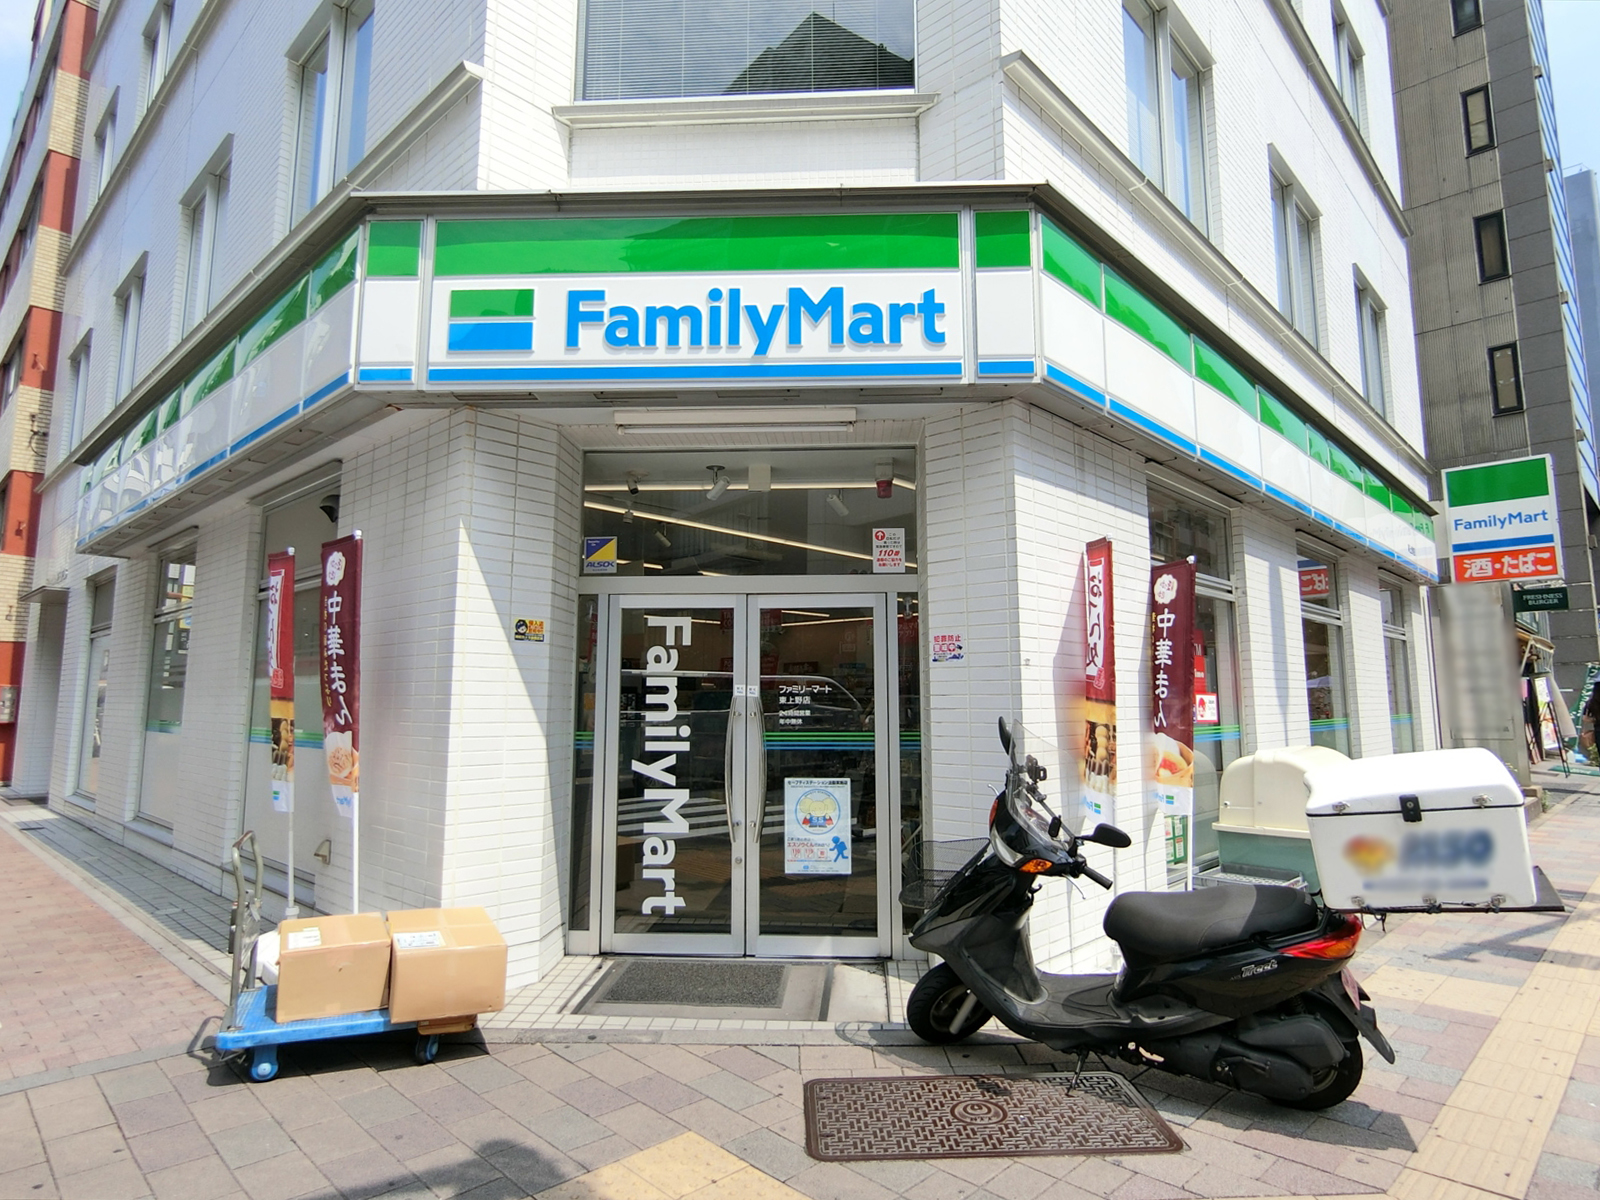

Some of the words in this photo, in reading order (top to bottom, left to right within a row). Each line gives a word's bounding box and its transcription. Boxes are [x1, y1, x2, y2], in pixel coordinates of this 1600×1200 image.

[566, 286, 947, 357] FamilyMart
[1453, 509, 1549, 531] FamilyMart
[1463, 552, 1553, 578] 酒・たばこ
[779, 685, 833, 694] ファミリーマート
[779, 696, 811, 704] 東上野店
[631, 616, 692, 915] FamilyMart
